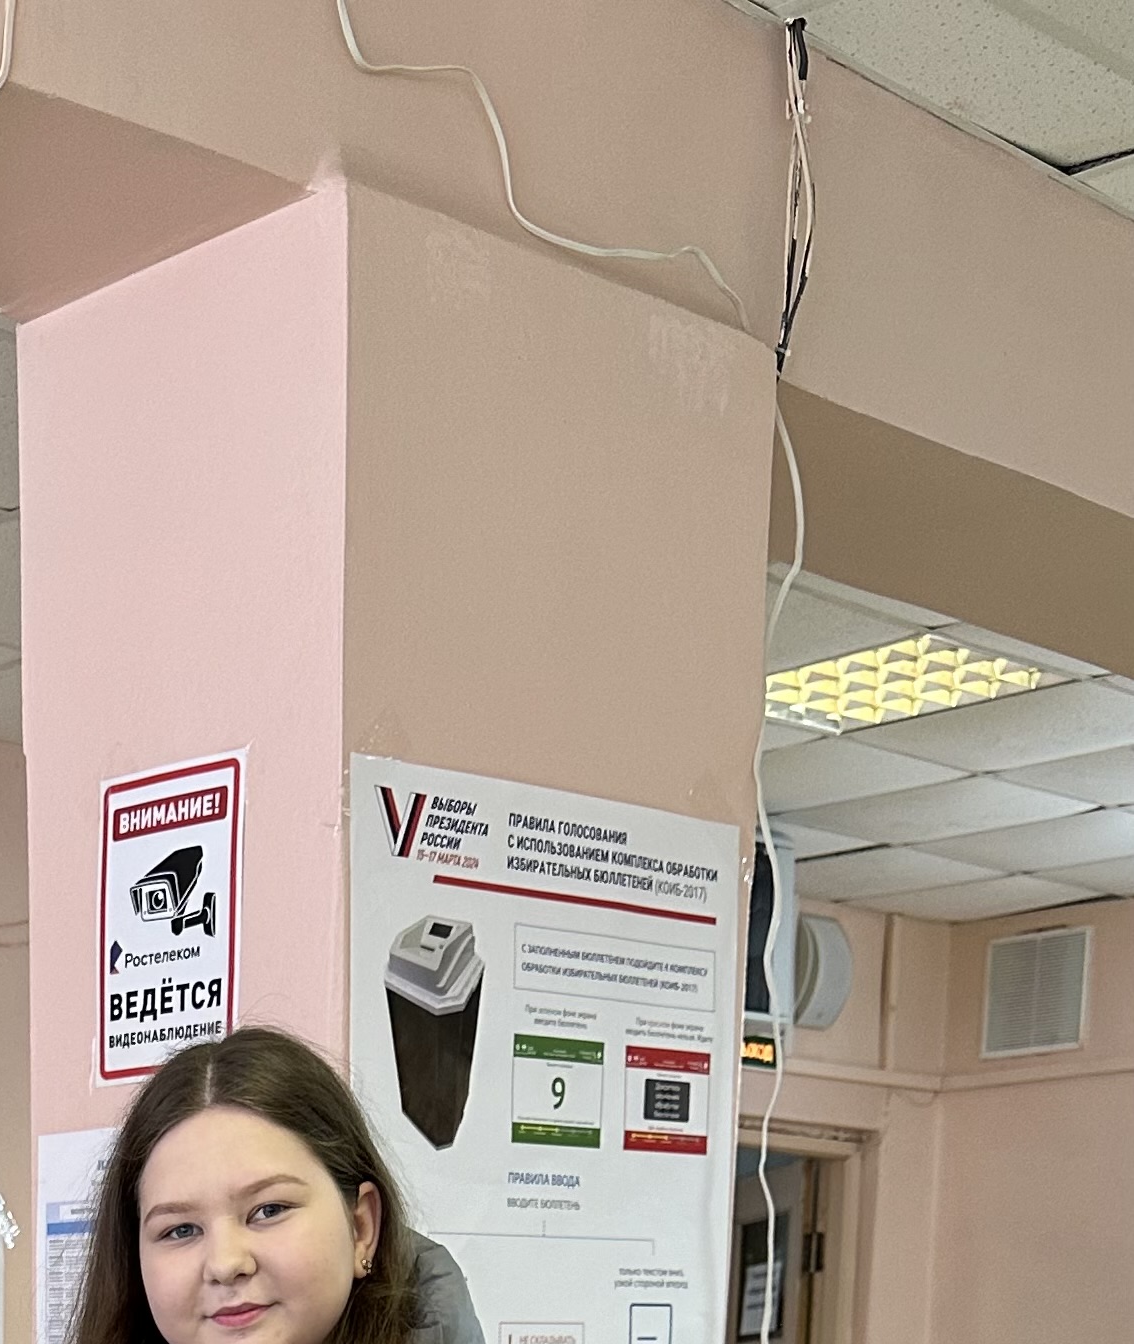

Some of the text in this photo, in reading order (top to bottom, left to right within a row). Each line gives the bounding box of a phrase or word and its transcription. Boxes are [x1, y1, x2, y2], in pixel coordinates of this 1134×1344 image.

[118, 793, 220, 834] ВНИМАНИЕ!
[430, 796, 477, 816] ВЫБОРЫ
[425, 814, 489, 837] ПРЕЗИДЕНТА
[508, 812, 627, 846] ПРАВИЛА ГОЛОСОВАНИЯ
[420, 831, 462, 850] РОССИИ
[436, 851, 461, 866] МАРТА
[507, 834, 718, 882] С ИСПОЛЬЗОВАНИЕМ КОМПЛЕКСА ОБРАБОТКИ
[507, 855, 592, 882] ИЗБИРАТЕЛЬНЫХ
[593, 868, 653, 892] БЮЛЛЕТЕНЕЙ
[124, 945, 201, 969] Ростелеком
[109, 977, 222, 1023] ВЕДЁТСЯ
[109, 1021, 222, 1049] ВИДЕОНАБЛЮДЕНИЕ
[551, 1077, 566, 1110] 9
[508, 1172, 580, 1189] ПРАВИЛА ВВОДА
